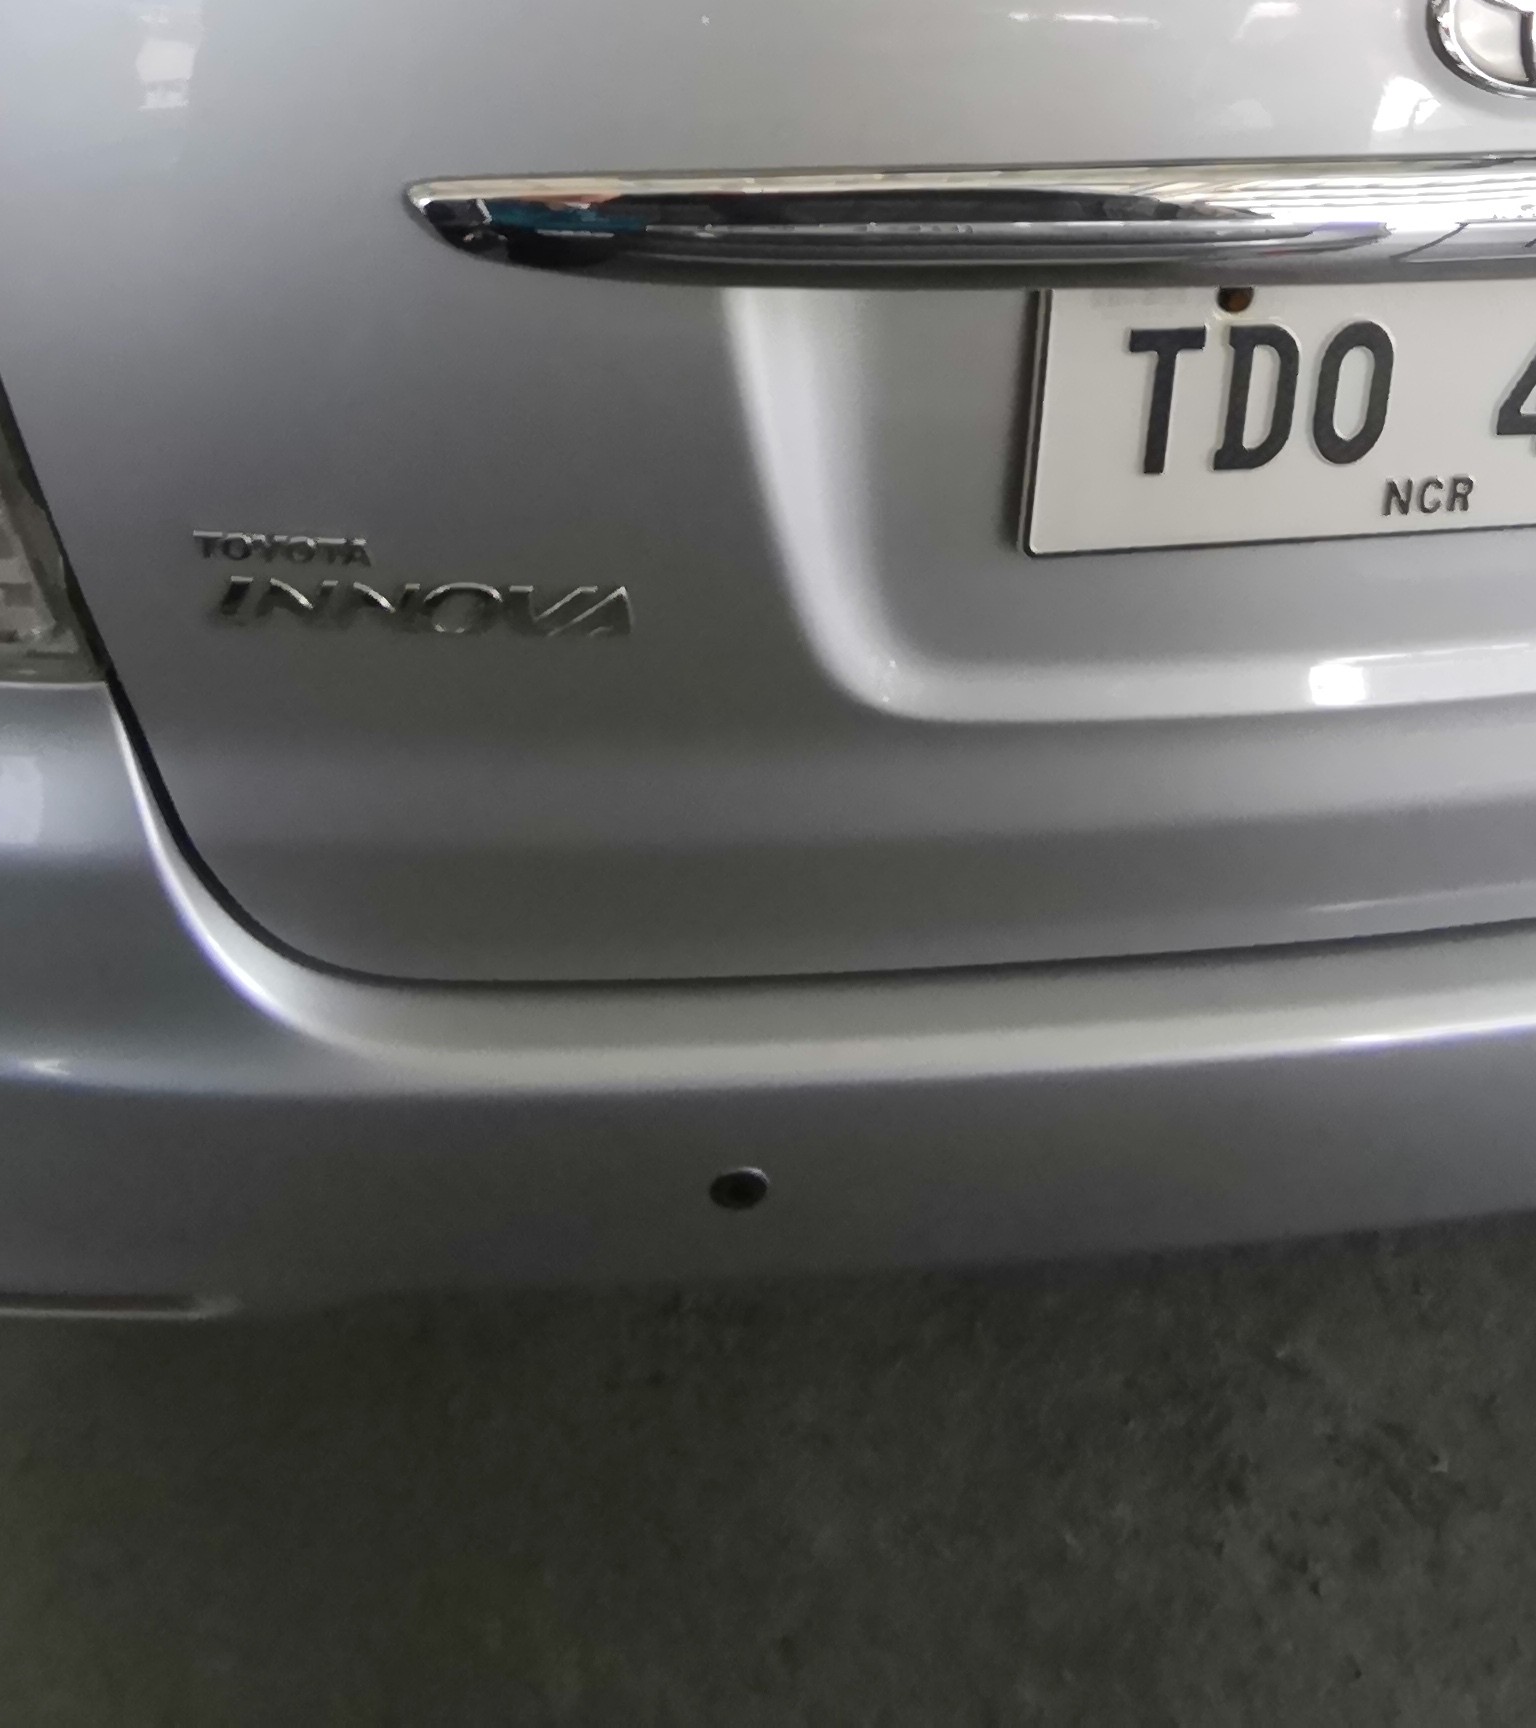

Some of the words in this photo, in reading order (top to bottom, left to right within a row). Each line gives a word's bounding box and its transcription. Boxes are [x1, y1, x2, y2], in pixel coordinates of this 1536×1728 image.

[1128, 319, 1396, 475] TDO
[1382, 476, 1476, 516] NCR
[192, 529, 373, 566] TOYOTA
[221, 575, 634, 637] INNOVA
